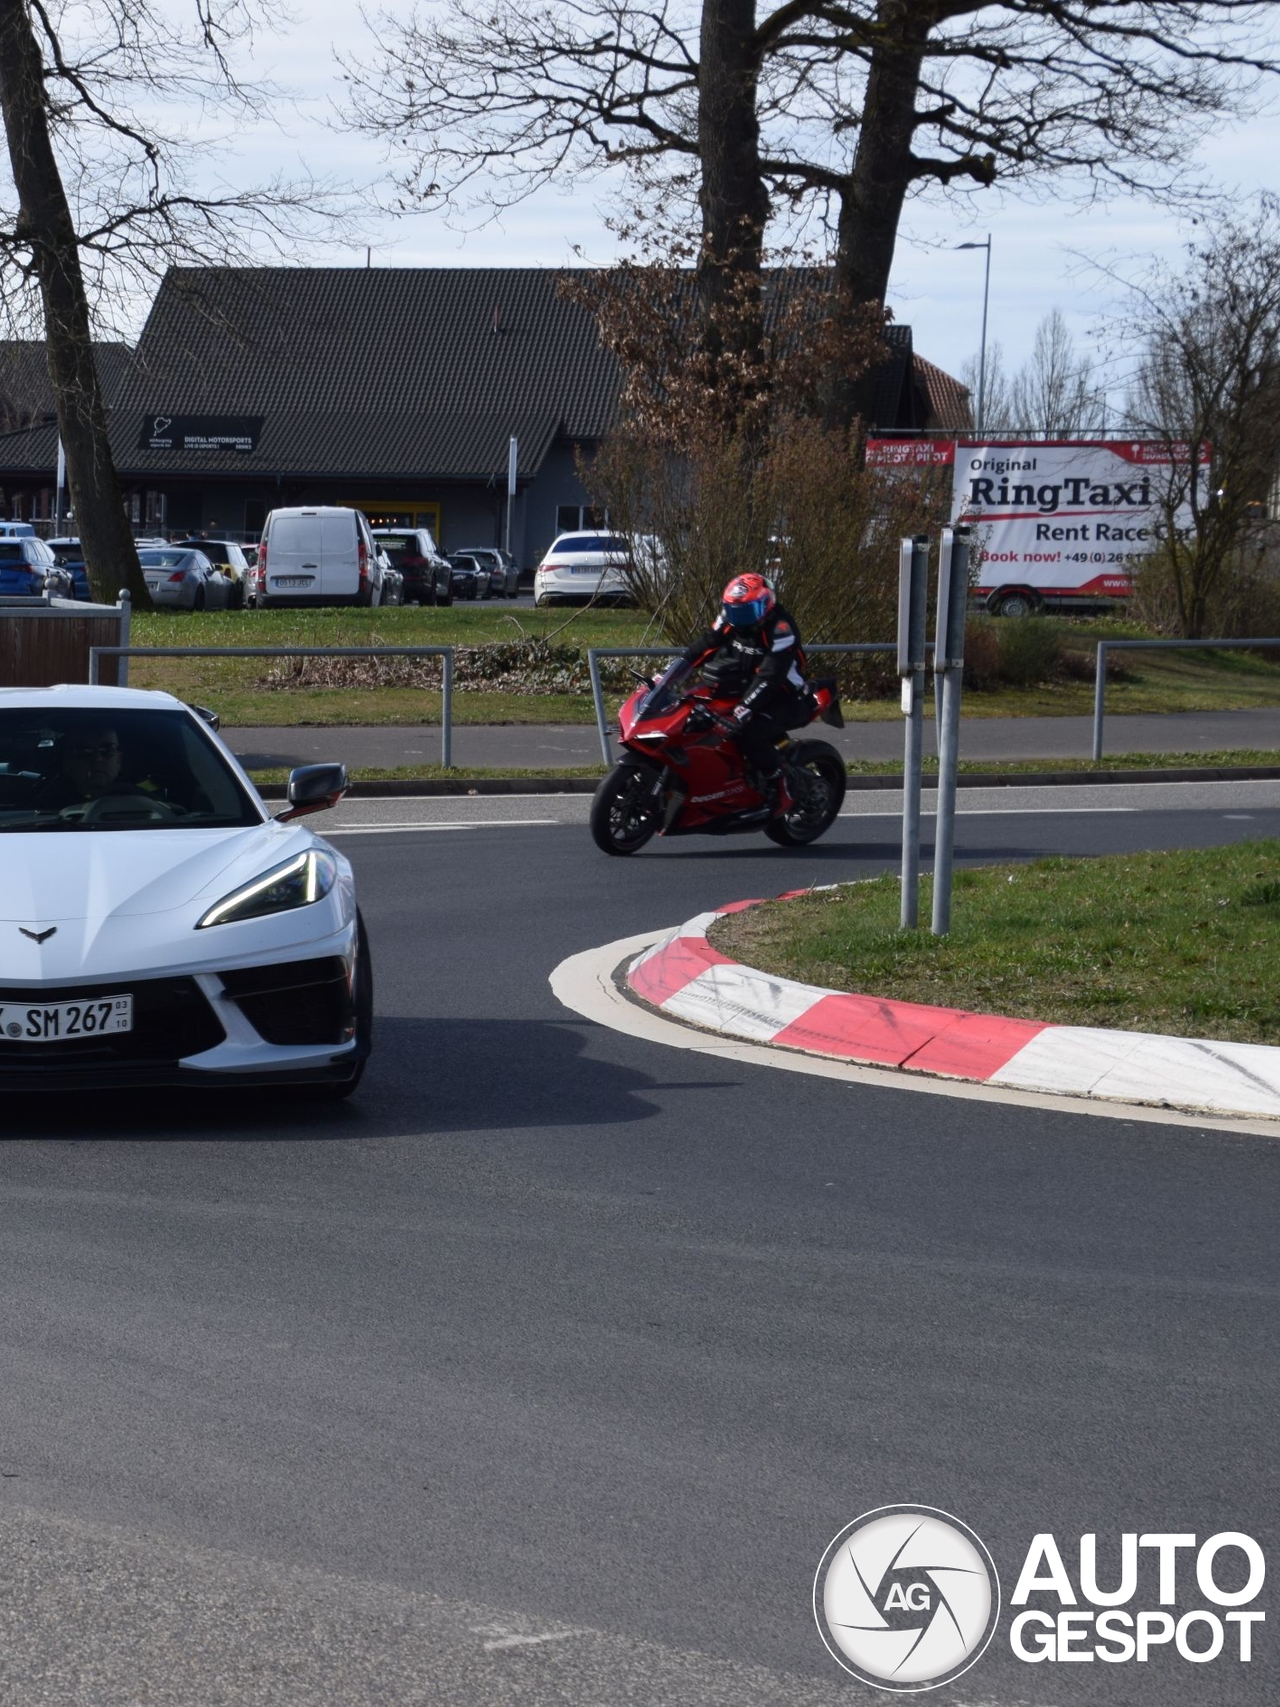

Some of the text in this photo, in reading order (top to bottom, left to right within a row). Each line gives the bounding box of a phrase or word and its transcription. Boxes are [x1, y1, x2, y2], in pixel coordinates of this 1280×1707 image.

[970, 458, 1037, 474] Original
[969, 477, 1152, 513] RingTaxi
[1036, 524, 1090, 541] Rent
[1096, 524, 1148, 541] Race
[981, 551, 1018, 562] Book
[1024, 551, 1061, 562] now!
[1065, 553, 1087, 562] +49
[1089, 553, 1106, 564] (0)
[115, 1001, 127, 1009] 03
[26, 1008, 59, 1038] SM
[66, 1002, 113, 1034] 267
[116, 1019, 127, 1028] 10
